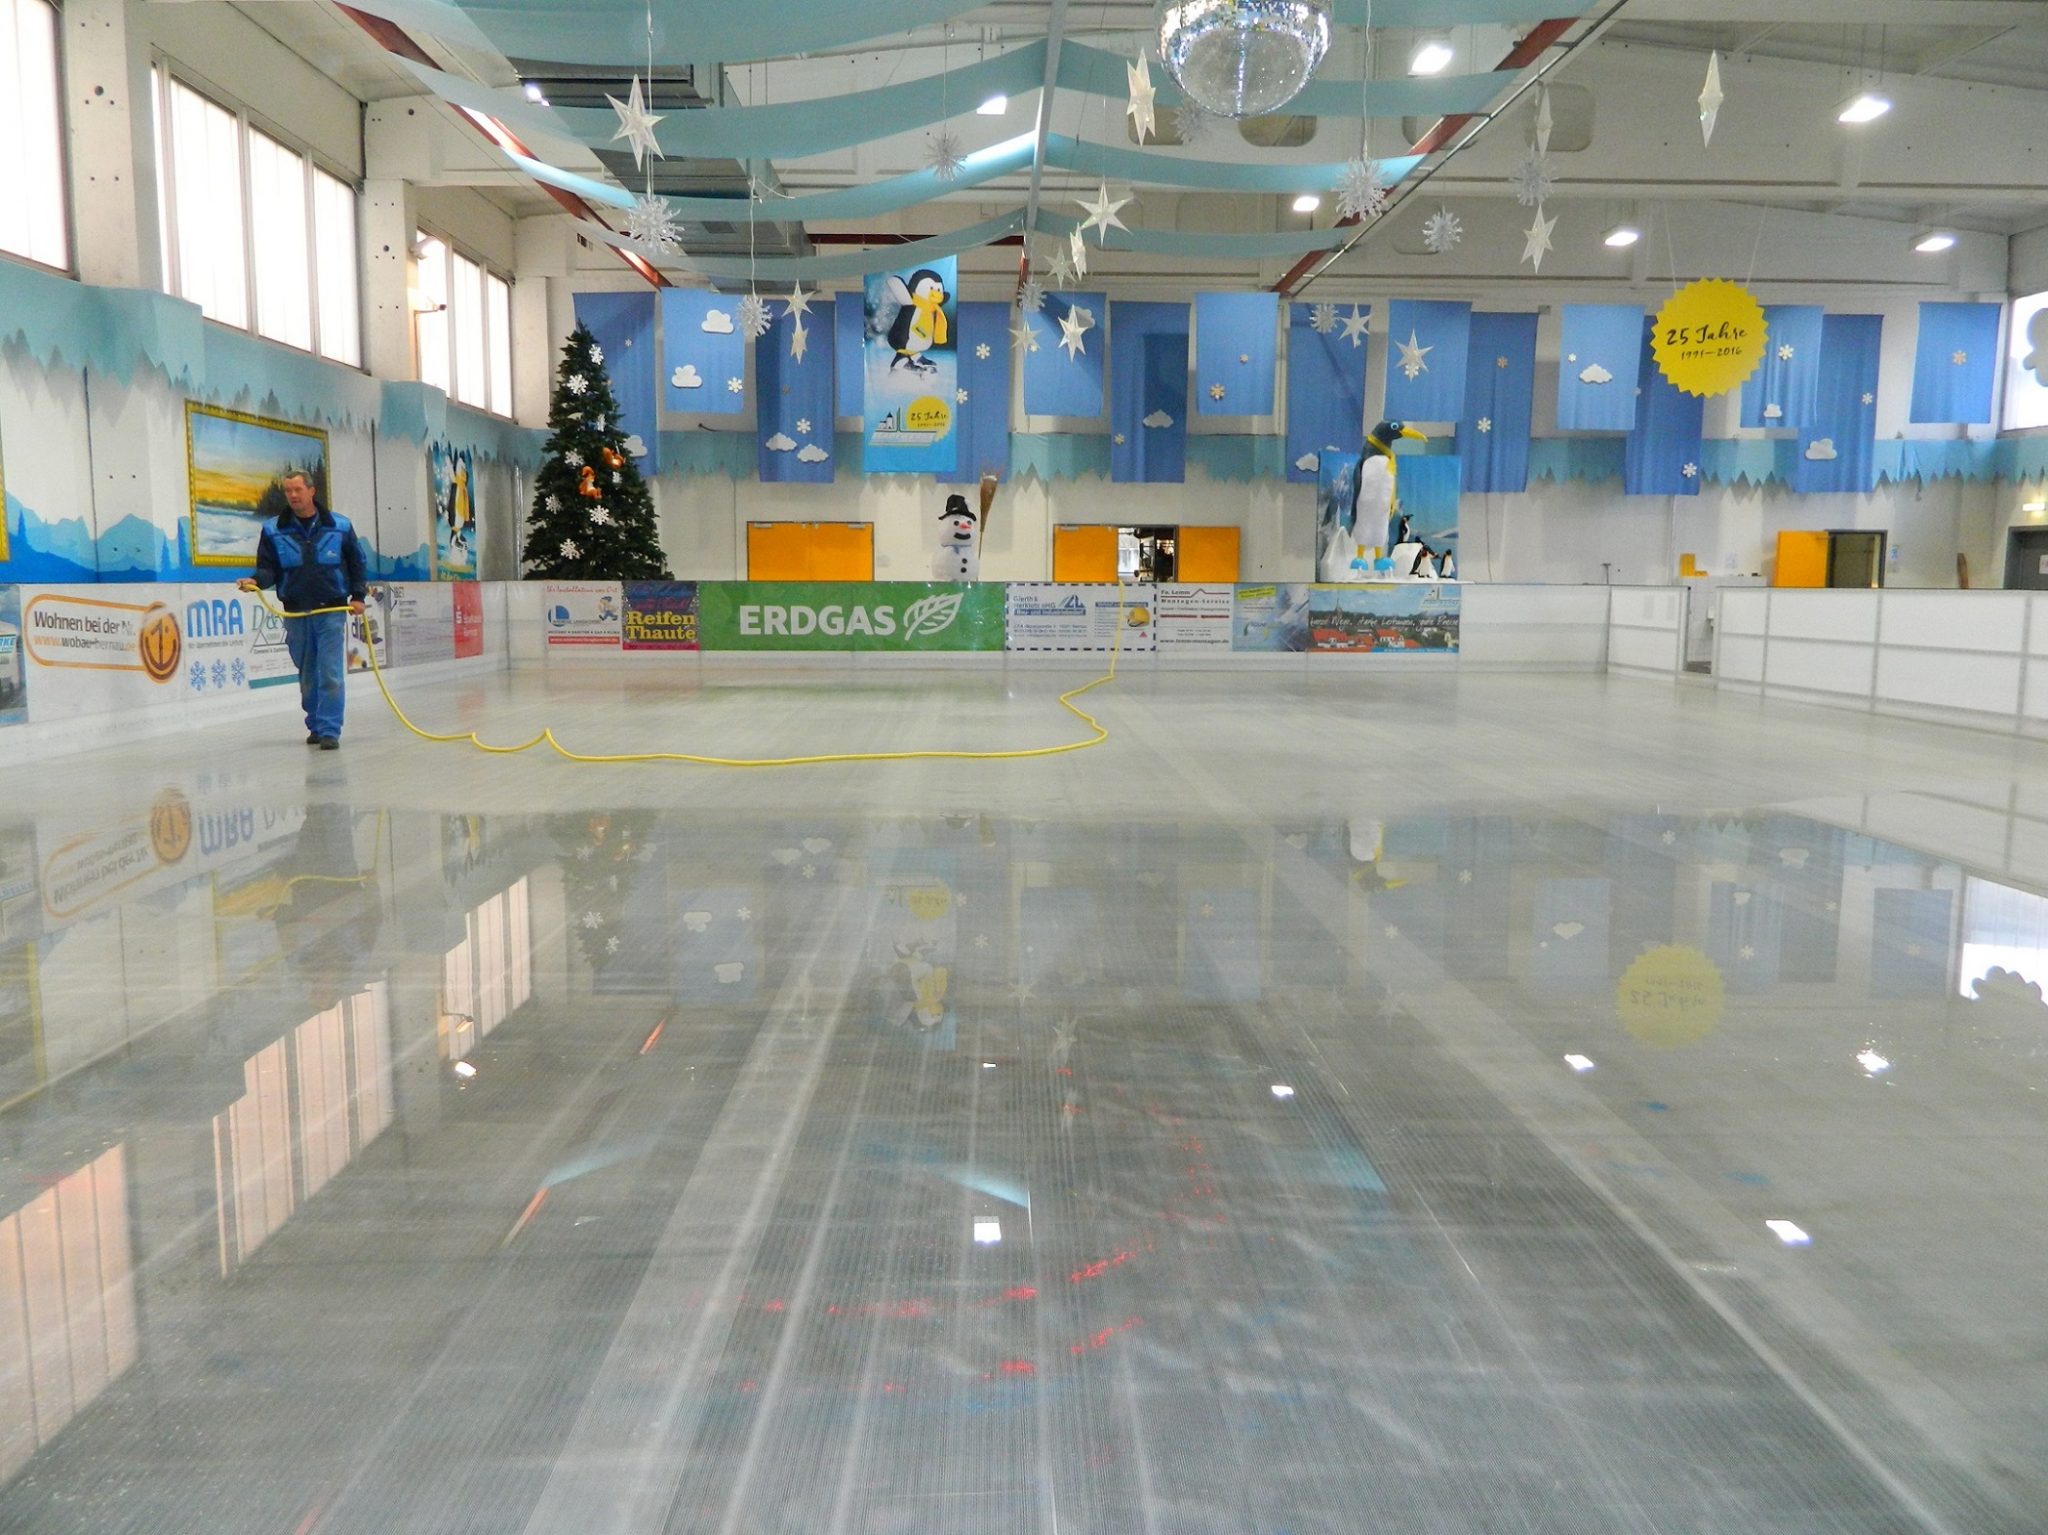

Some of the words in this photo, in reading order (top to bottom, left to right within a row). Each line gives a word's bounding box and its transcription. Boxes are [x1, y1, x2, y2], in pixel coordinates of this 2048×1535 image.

[1666, 327, 1689, 346] 25
[1695, 320, 1748, 344] Jahre
[34, 610, 83, 632] Wohnen
[85, 615, 101, 633] bei
[103, 618, 120, 634] der
[187, 599, 244, 638] MRA
[626, 610, 696, 625] Reifen
[739, 604, 897, 636] ERDGAS
[625, 625, 696, 640] Thaute
